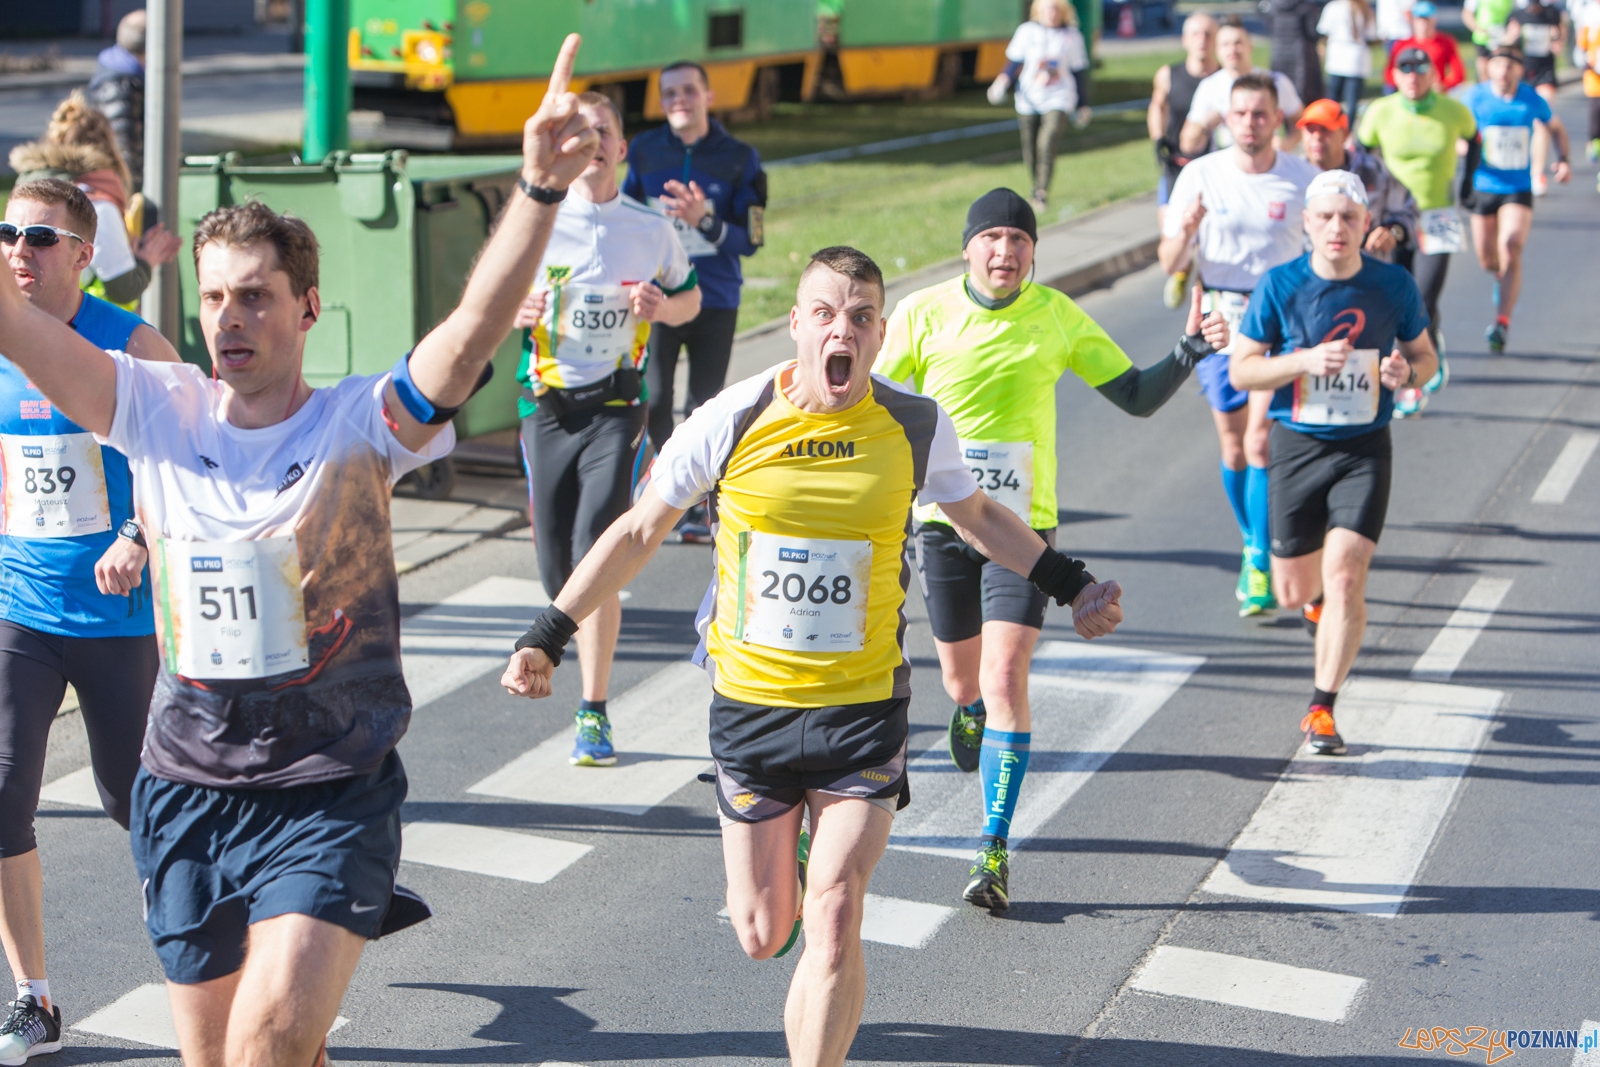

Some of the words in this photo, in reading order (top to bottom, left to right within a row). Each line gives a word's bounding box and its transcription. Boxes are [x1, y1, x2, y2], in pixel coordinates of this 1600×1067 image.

[572, 308, 629, 330] 8307
[1310, 372, 1370, 391] 11414
[24, 465, 76, 494] 839
[34, 498, 69, 506] Mateusz
[760, 569, 852, 605] 2068
[199, 585, 258, 621] 511
[789, 607, 821, 617] Adrian
[220, 626, 242, 638] Filip
[991, 750, 1020, 813] Kalenji
